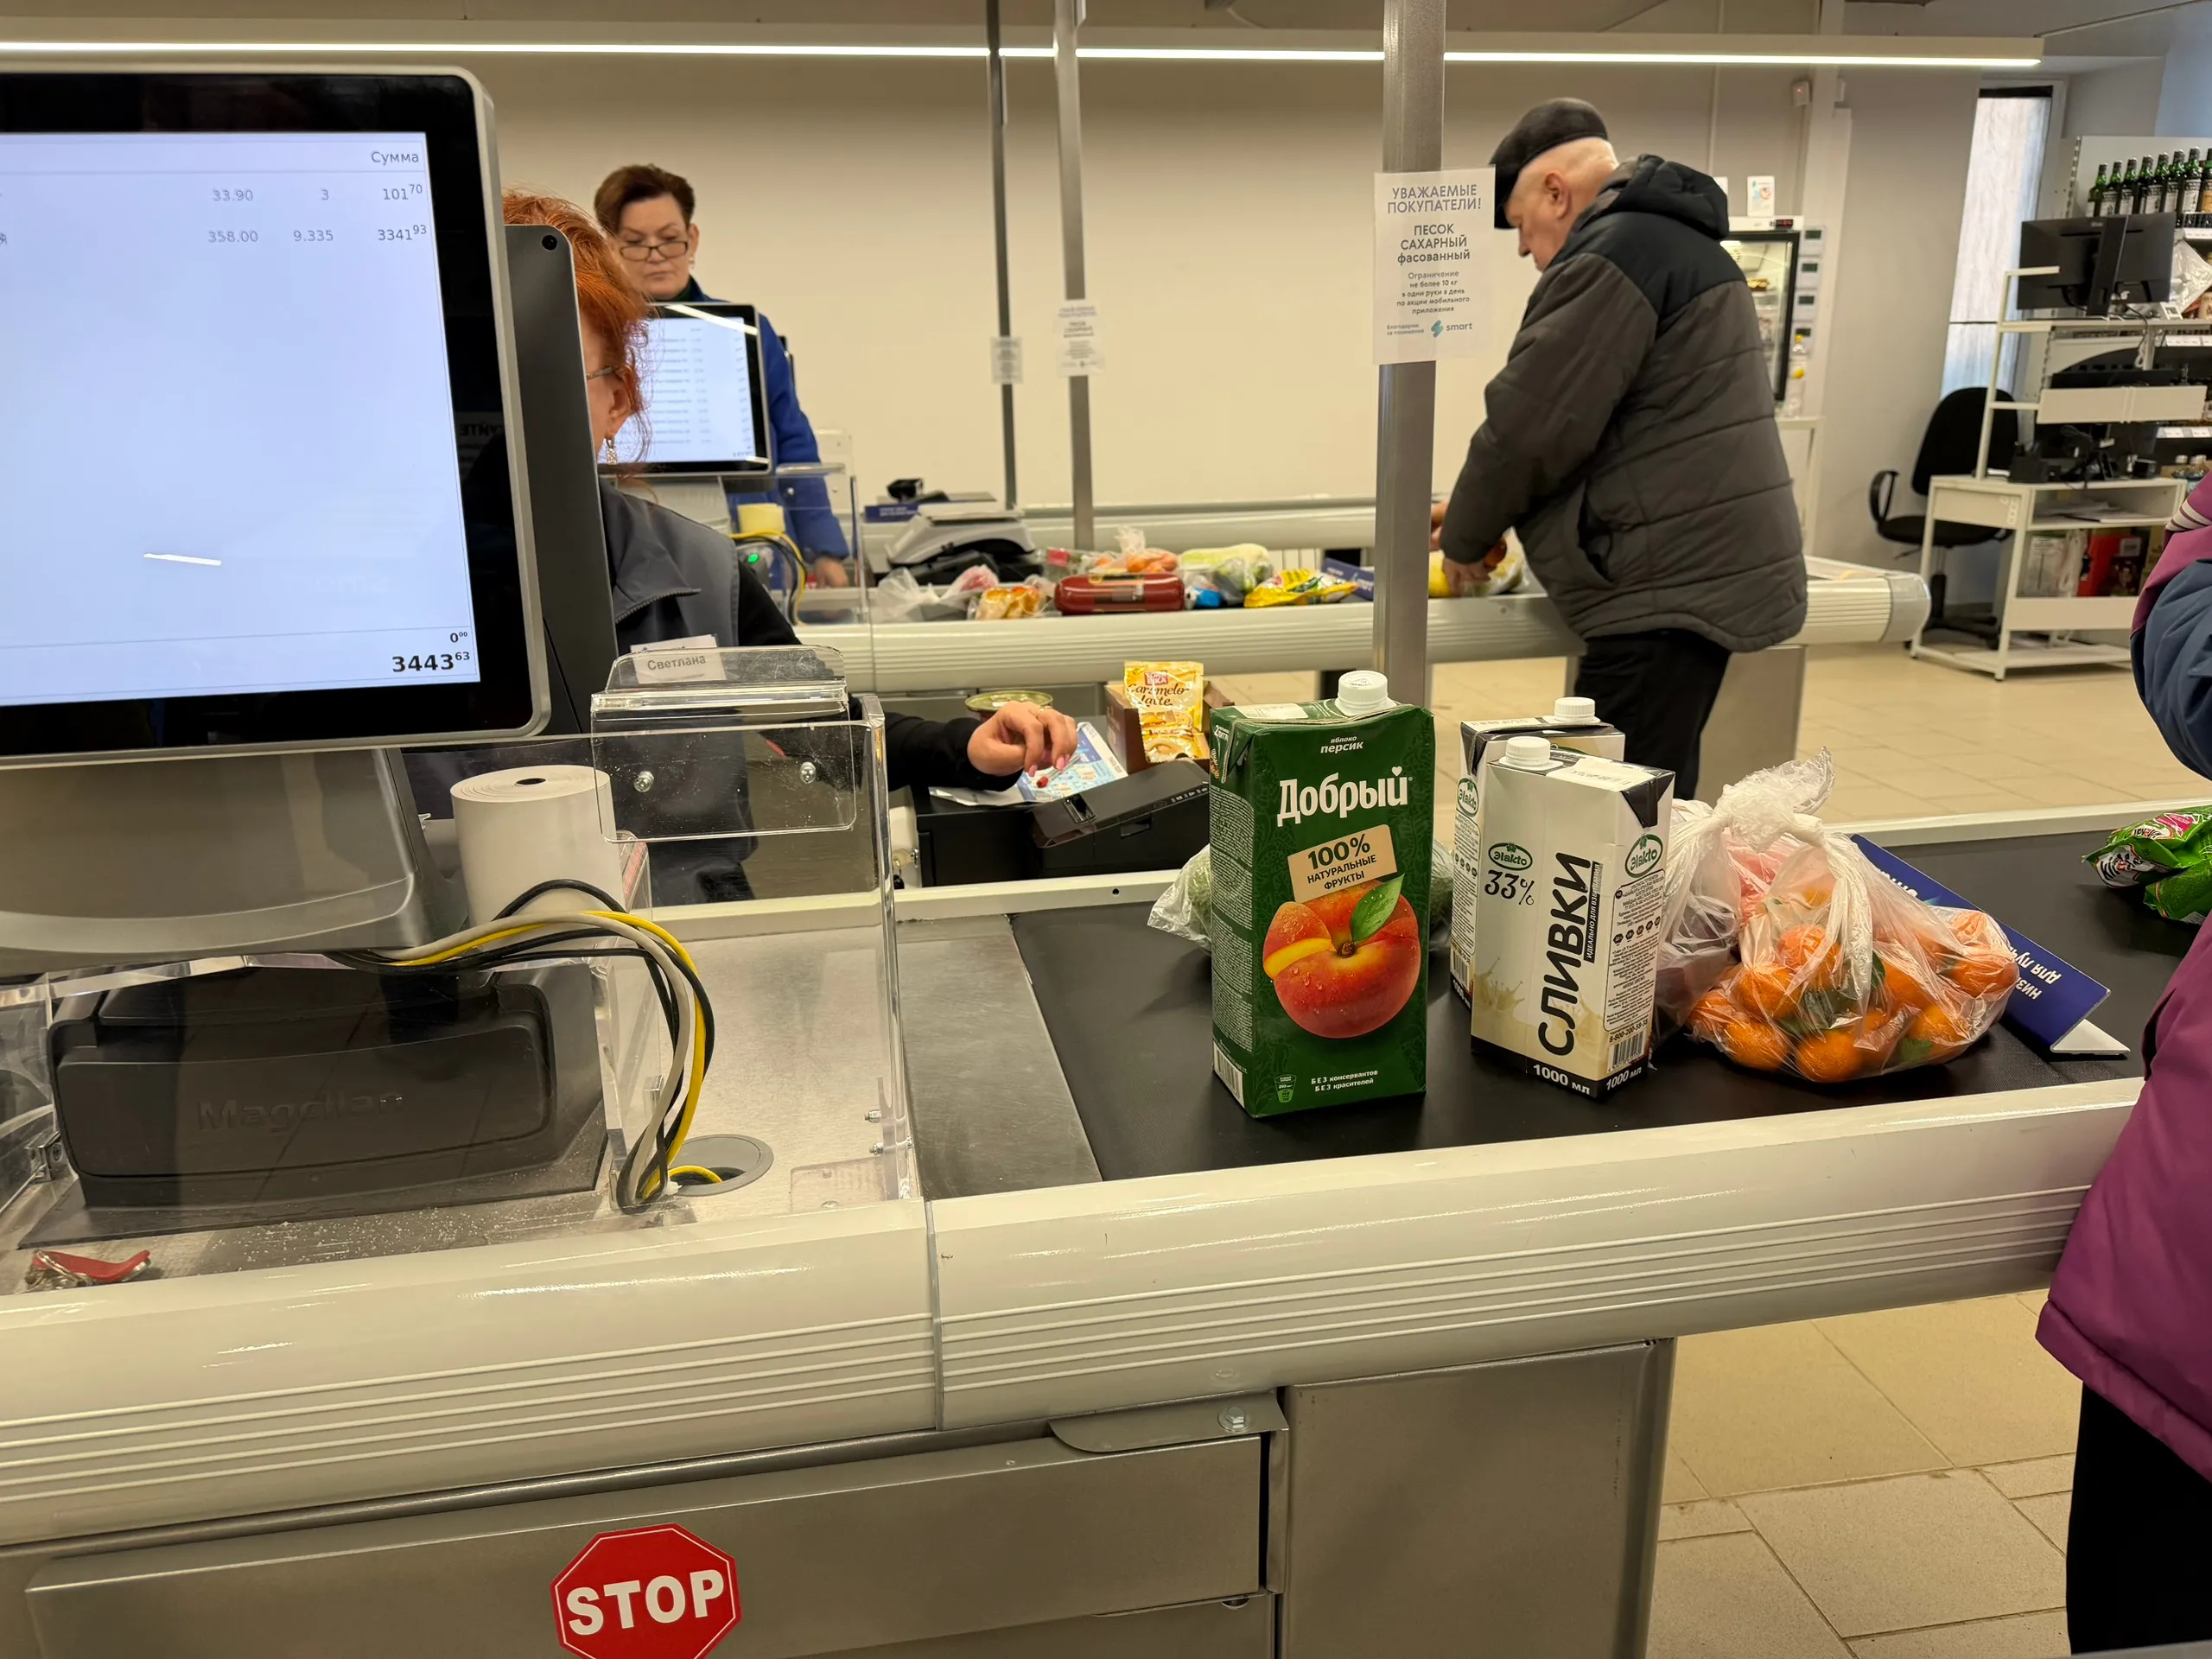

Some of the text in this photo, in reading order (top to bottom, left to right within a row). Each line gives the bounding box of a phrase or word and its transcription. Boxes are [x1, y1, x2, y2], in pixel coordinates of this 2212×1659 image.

[371, 150, 419, 165] Сумма
[212, 189, 253, 201] 33.90
[321, 188, 329, 200] 3
[1392, 184, 1477, 200] УВАЖАЕМЫЕ
[1388, 198, 1482, 213] ПОКУПАТЕЛИ!
[207, 230, 258, 243] 358.00
[293, 230, 334, 242] 9.335
[1414, 224, 1454, 236] ПЕСОК
[1401, 234, 1467, 251] САХАРНЫЙ
[1397, 250, 1471, 265] фасованный
[1408, 270, 1459, 280] Ограничение
[1412, 307, 1454, 315] приложения
[1446, 322, 1472, 331] smart
[647, 656, 706, 671] Светлана
[1320, 741, 1363, 753] персик
[1331, 735, 1357, 744] яблоко
[1277, 766, 1408, 827] Добрый
[1307, 833, 1371, 870] 100%
[1306, 855, 1377, 884] НАТУРАЛЬНЫЕ
[1324, 871, 1365, 890] ФРУКТЫ
[1484, 869, 1535, 906] 33%
[1586, 920, 1596, 959] ИДЕАЛЬНО
[1538, 853, 1592, 1056] СЛИВКИ
[1330, 1071, 1378, 1082] консервантов
[1534, 1064, 1591, 1095] 1000 мл
[1606, 1066, 1642, 1090] 1000 мл
[1315, 1077, 1374, 1092] БЕЗ красителей
[197, 1090, 404, 1133] Magellan
[566, 1568, 724, 1636] STOP
